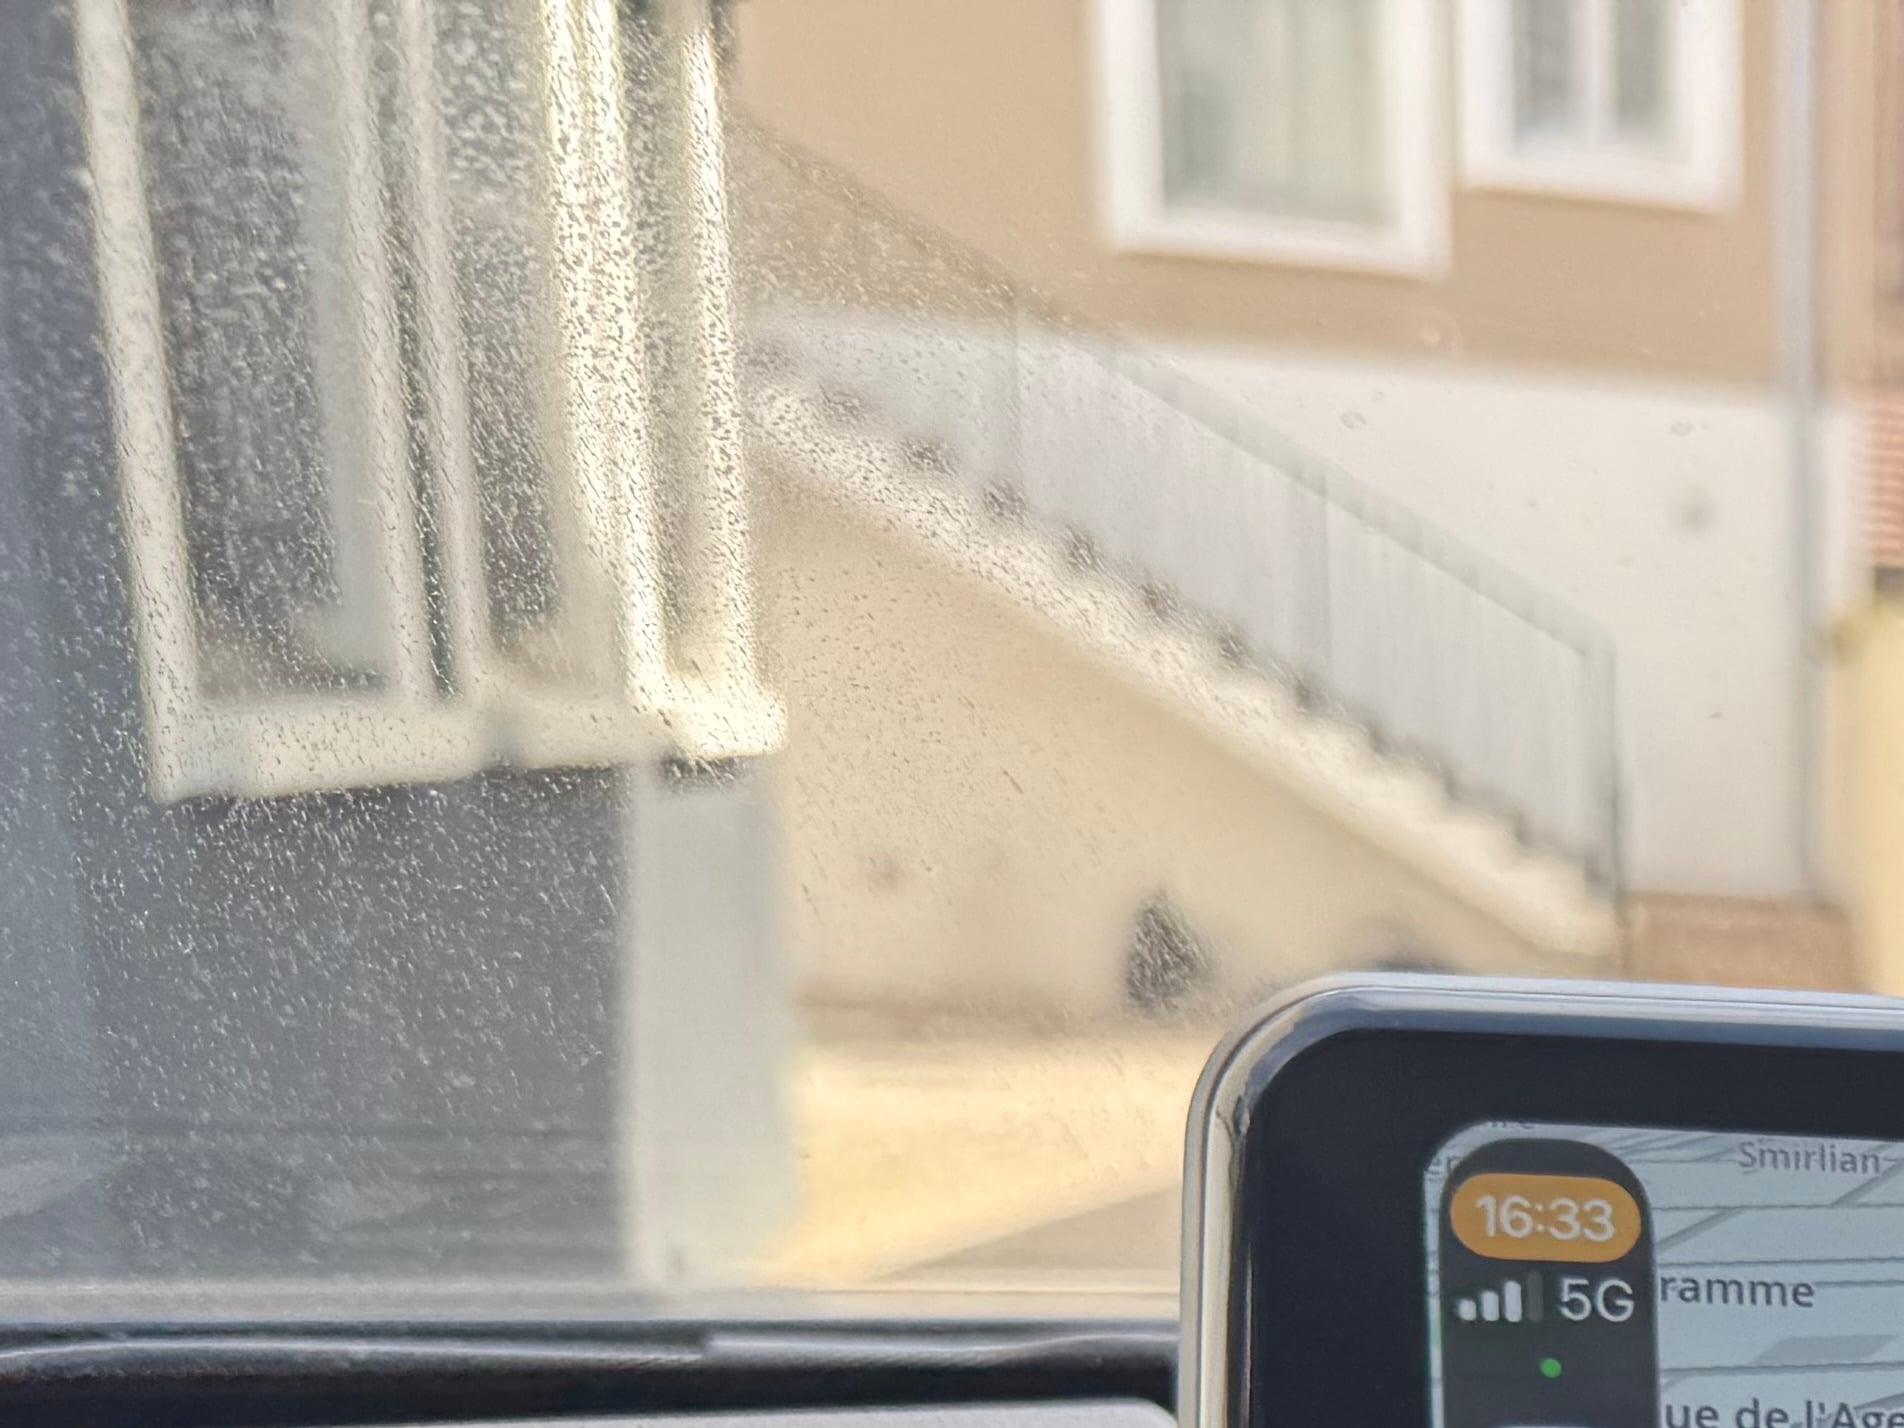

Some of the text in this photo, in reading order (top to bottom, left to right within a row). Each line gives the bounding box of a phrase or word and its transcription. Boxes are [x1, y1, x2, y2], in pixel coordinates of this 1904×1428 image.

[1738, 1141, 1882, 1174] Smirlian
[1476, 1195, 1616, 1242] 16:33
[1560, 1278, 1636, 1323] 5G
